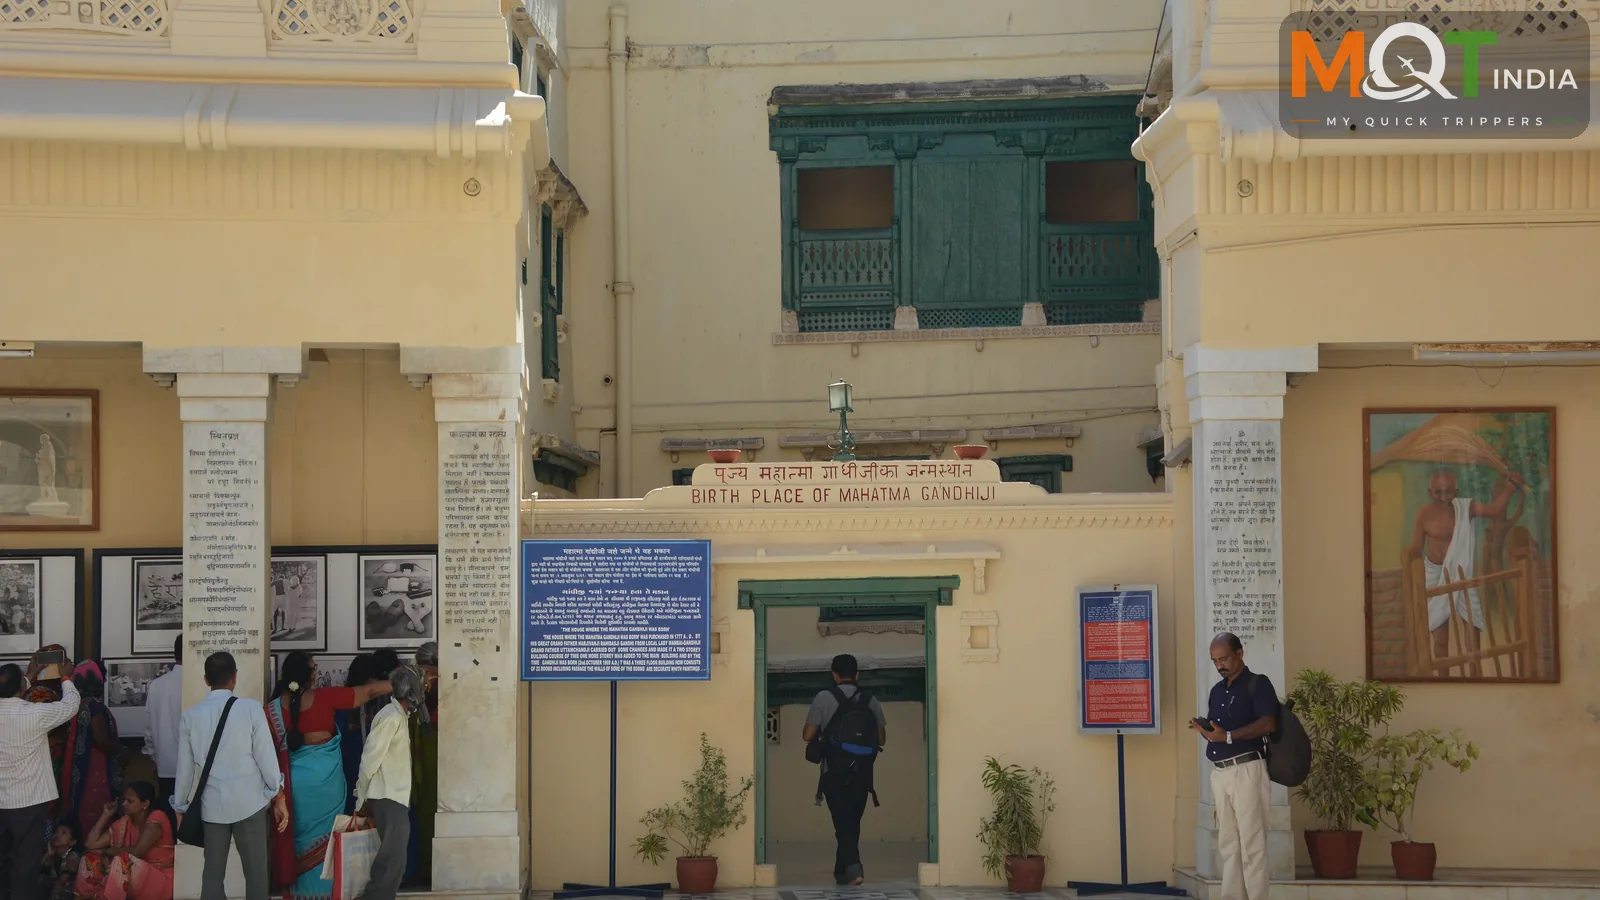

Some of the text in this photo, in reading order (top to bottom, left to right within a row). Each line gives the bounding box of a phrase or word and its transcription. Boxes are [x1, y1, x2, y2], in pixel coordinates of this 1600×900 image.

[714, 467, 748, 485] पूज्य
[759, 466, 813, 484] महात्मा
[906, 463, 973, 479] जन्मस्थान
[692, 486, 996, 504] BIRTH PLACE OF MAHATMA GANDHIJI
[165, 584, 183, 600] रा
